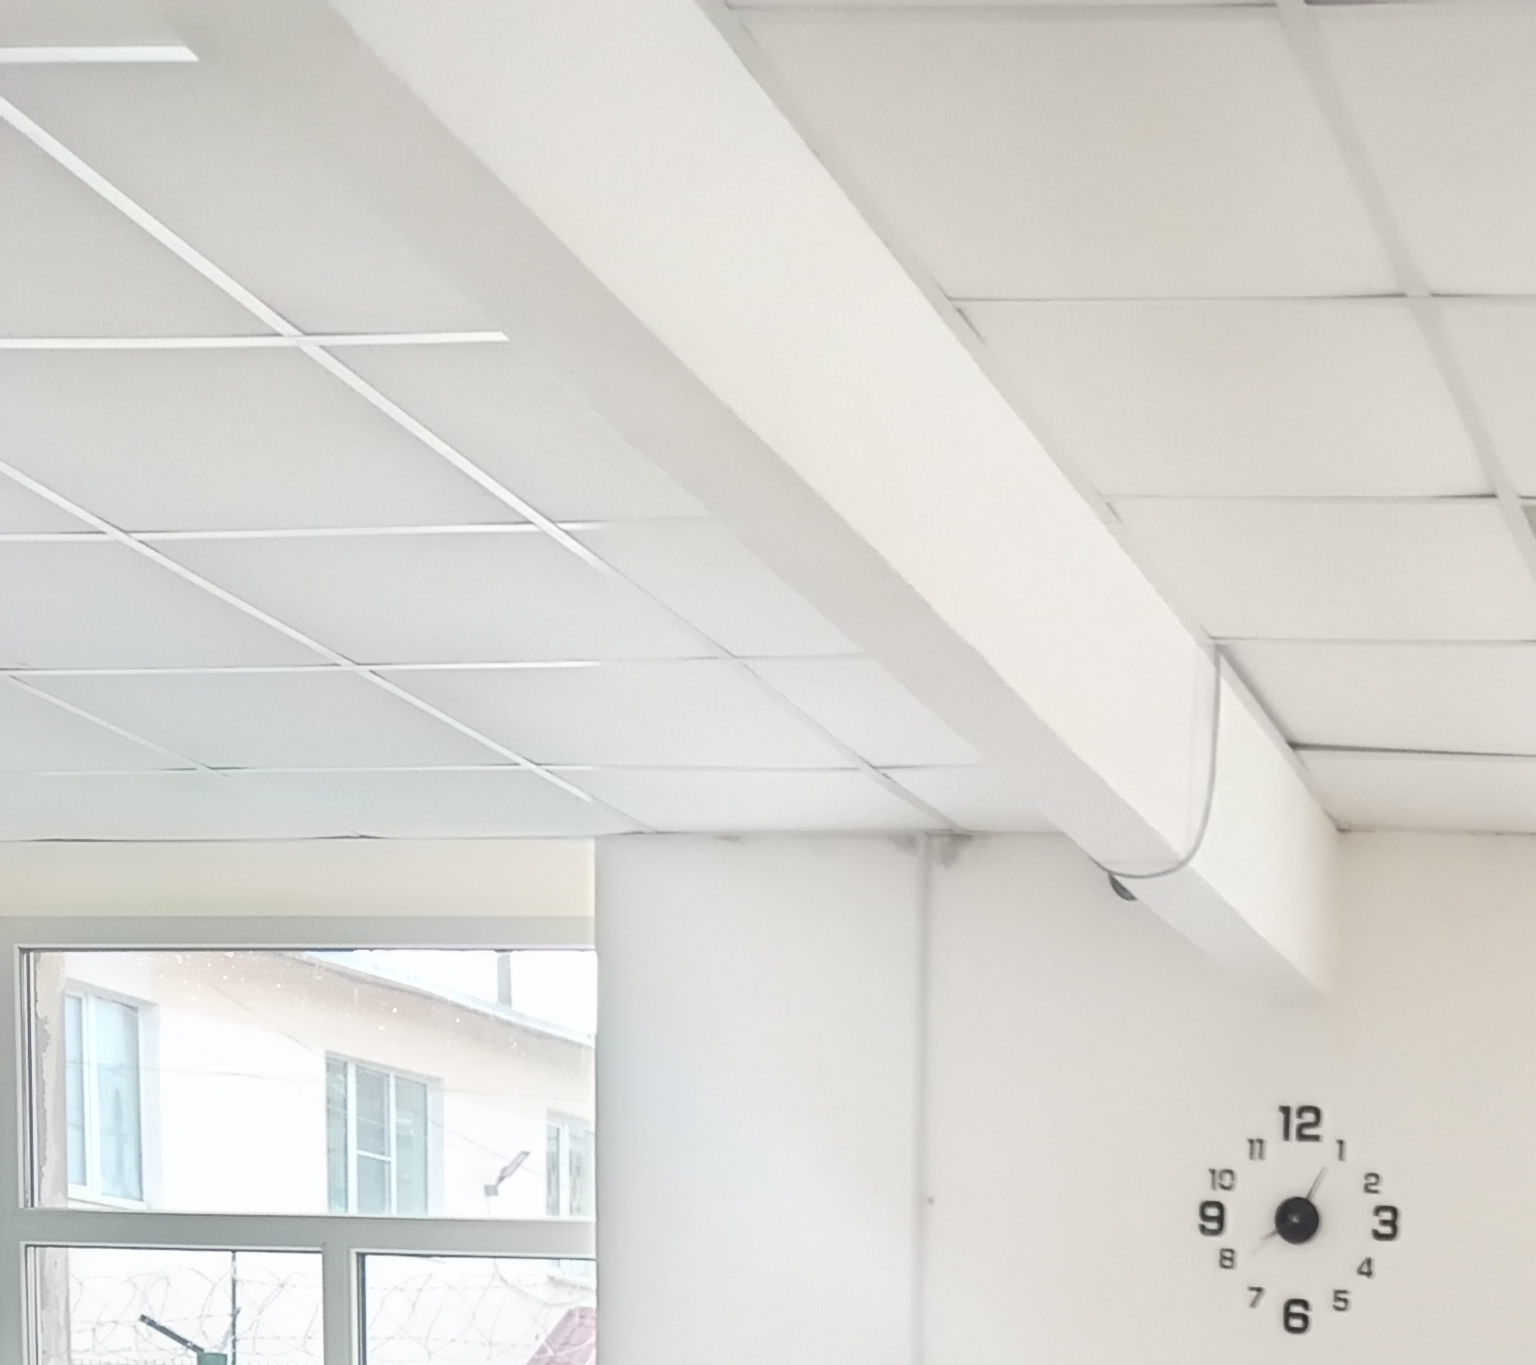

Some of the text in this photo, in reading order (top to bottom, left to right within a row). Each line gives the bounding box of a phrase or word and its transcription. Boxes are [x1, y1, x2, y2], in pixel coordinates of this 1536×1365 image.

[1278, 1105, 1322, 1142] 12
[1247, 1138, 1266, 1160] 11
[1336, 1139, 1346, 1161] 1
[1208, 1168, 1236, 1191] 10
[1363, 1172, 1381, 1194] 2
[1198, 1200, 1226, 1237] 9
[1371, 1205, 1399, 1242] 3
[1218, 1248, 1236, 1269] 8
[1356, 1257, 1374, 1279] 4
[1247, 1286, 1264, 1308] 7
[1332, 1289, 1350, 1311] 5
[1283, 1298, 1312, 1335] 6
